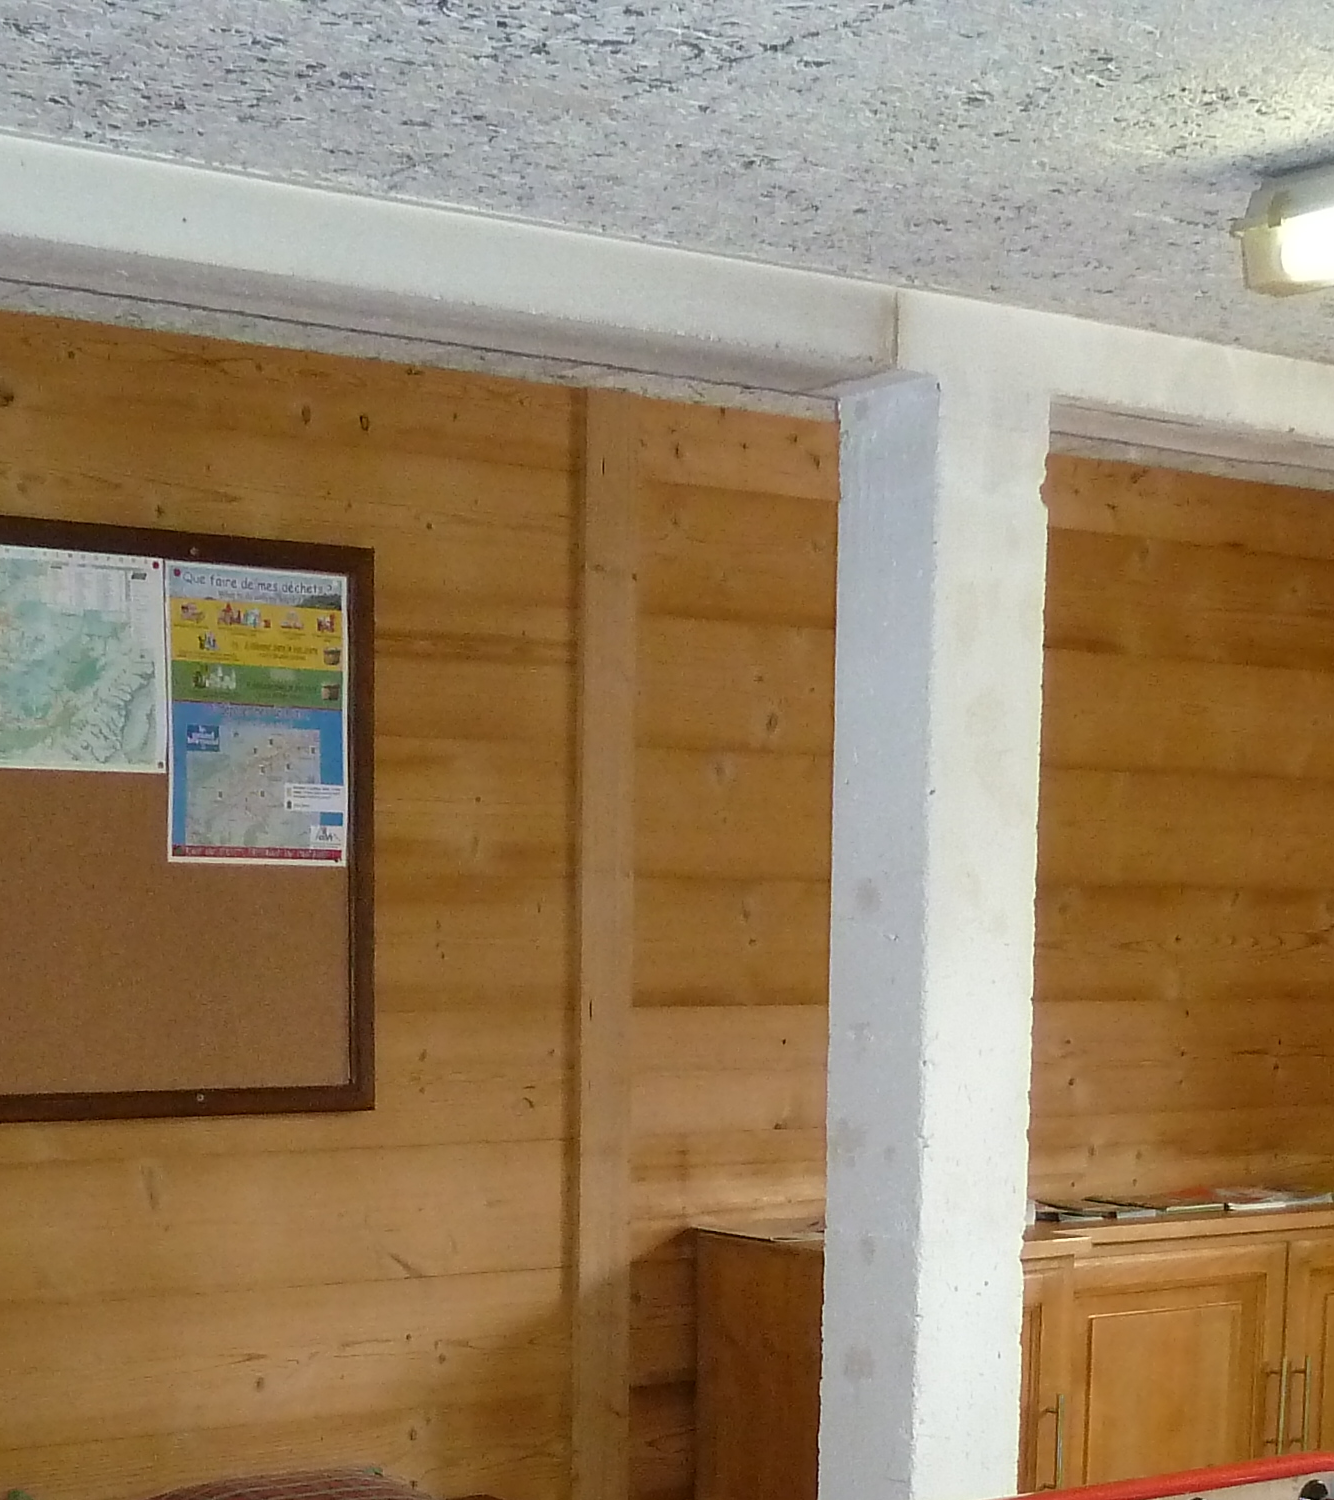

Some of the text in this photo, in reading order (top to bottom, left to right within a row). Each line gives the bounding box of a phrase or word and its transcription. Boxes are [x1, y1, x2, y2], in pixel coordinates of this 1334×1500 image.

[182, 571, 206, 585] Que
[210, 573, 237, 589] faire
[240, 576, 254, 591] de
[257, 582, 278, 592] mes
[281, 580, 323, 595] déchets
